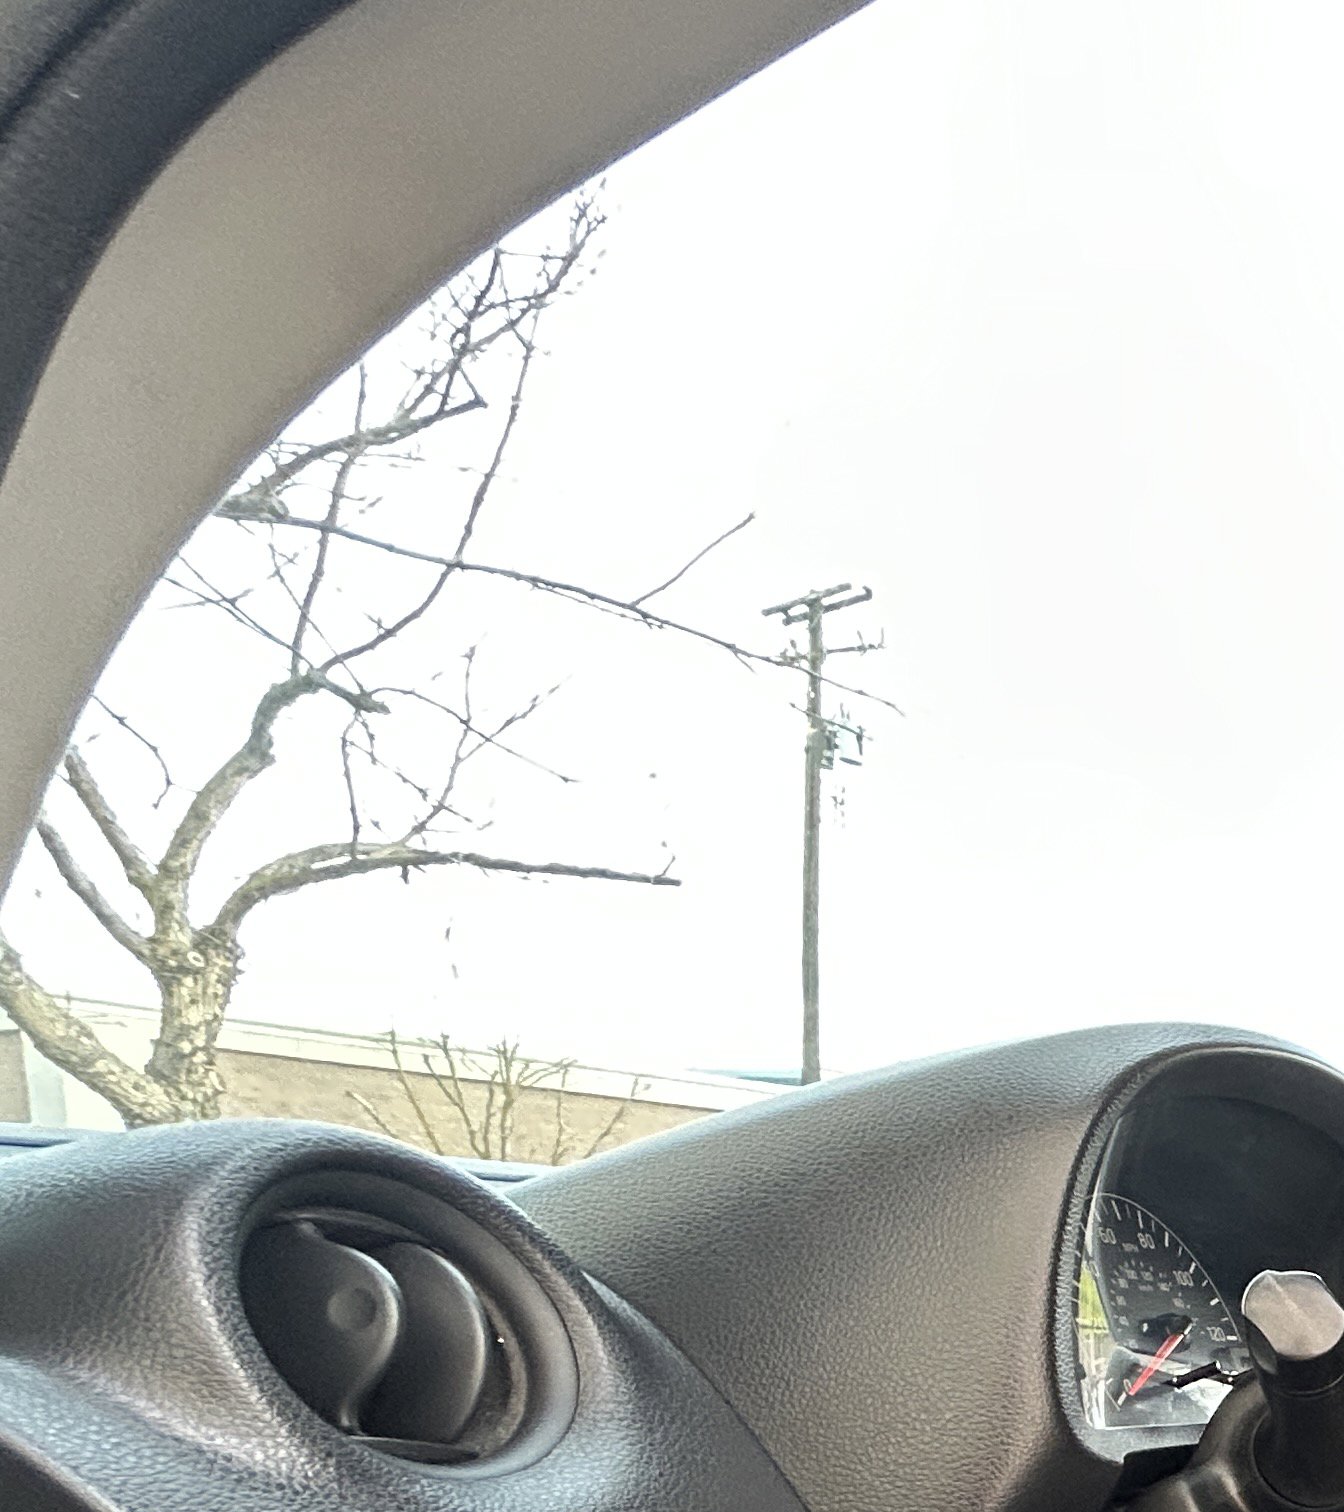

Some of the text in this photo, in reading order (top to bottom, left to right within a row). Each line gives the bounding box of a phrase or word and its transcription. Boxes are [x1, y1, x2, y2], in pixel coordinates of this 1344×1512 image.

[1098, 1227, 1116, 1244] 60
[1137, 1233, 1155, 1249] 80
[1173, 1270, 1194, 1287] 100
[1206, 1326, 1226, 1342] 120
